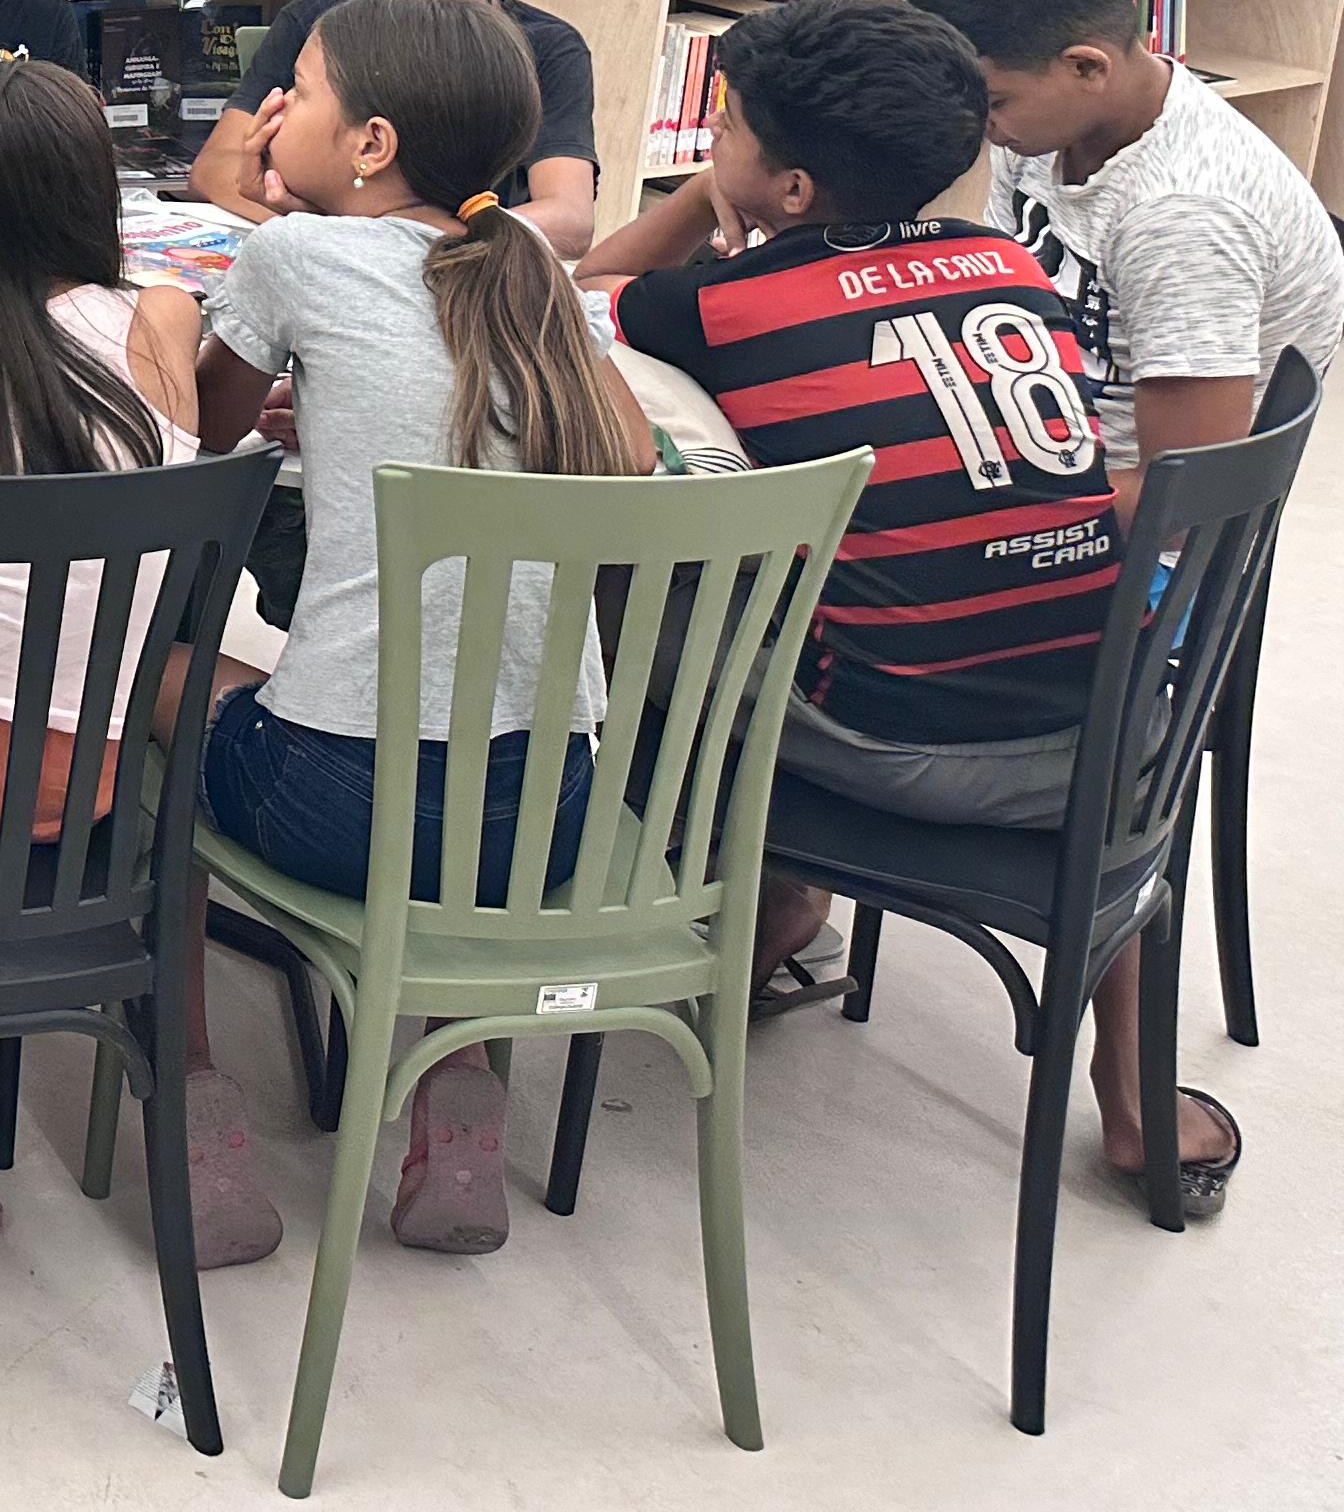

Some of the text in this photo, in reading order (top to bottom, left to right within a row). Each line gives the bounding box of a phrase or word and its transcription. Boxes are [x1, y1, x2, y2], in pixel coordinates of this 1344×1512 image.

[899, 221, 941, 239] livre
[838, 251, 1015, 301] DE LA CRUZ
[870, 302, 1097, 490] 18
[985, 519, 1101, 560] ASSIST
[1031, 535, 1110, 570] CARD
